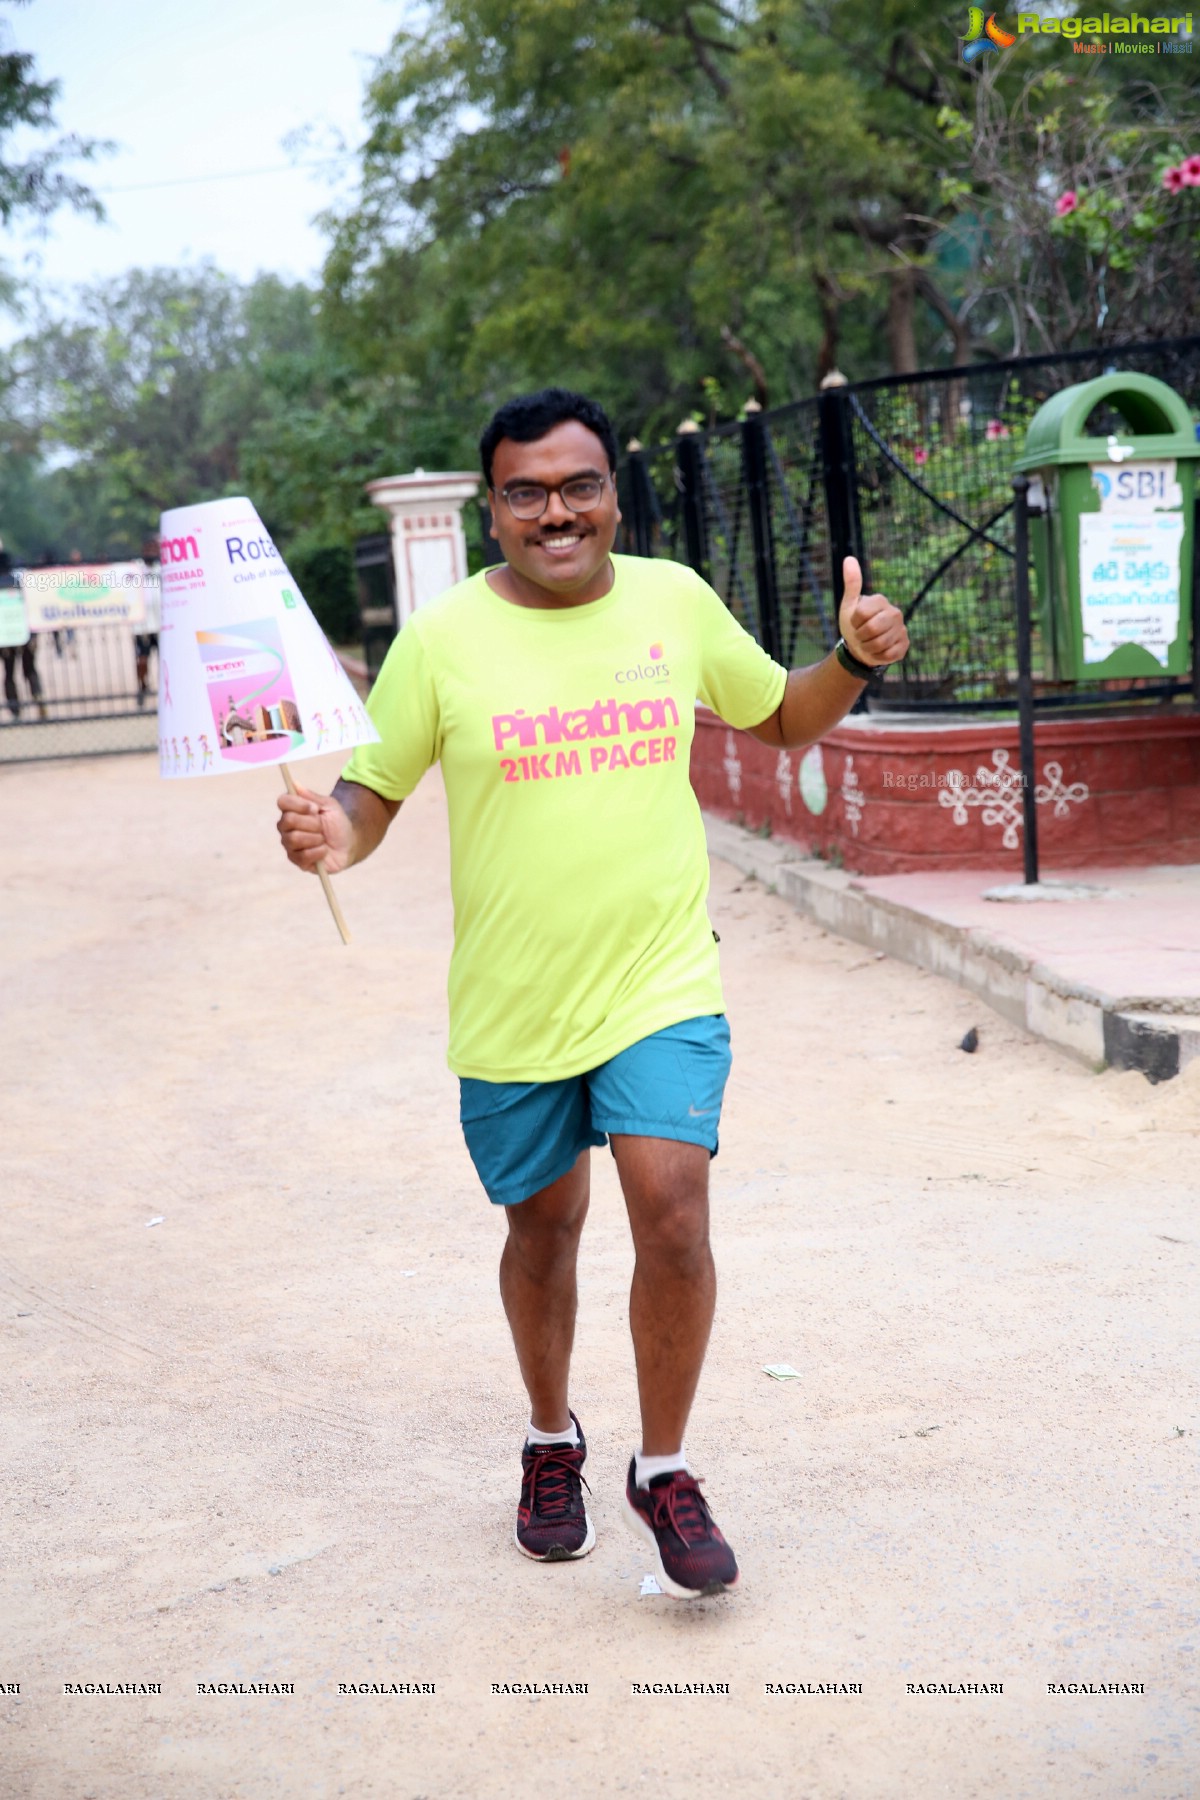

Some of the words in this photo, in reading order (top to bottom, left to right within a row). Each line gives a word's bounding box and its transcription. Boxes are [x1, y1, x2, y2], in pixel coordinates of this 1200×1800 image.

[1117, 470, 1167, 500] SBI
[615, 663, 670, 683] colors
[492, 697, 680, 751] Pinkathon
[500, 749, 582, 783] 21KM
[590, 736, 676, 773] PACER
